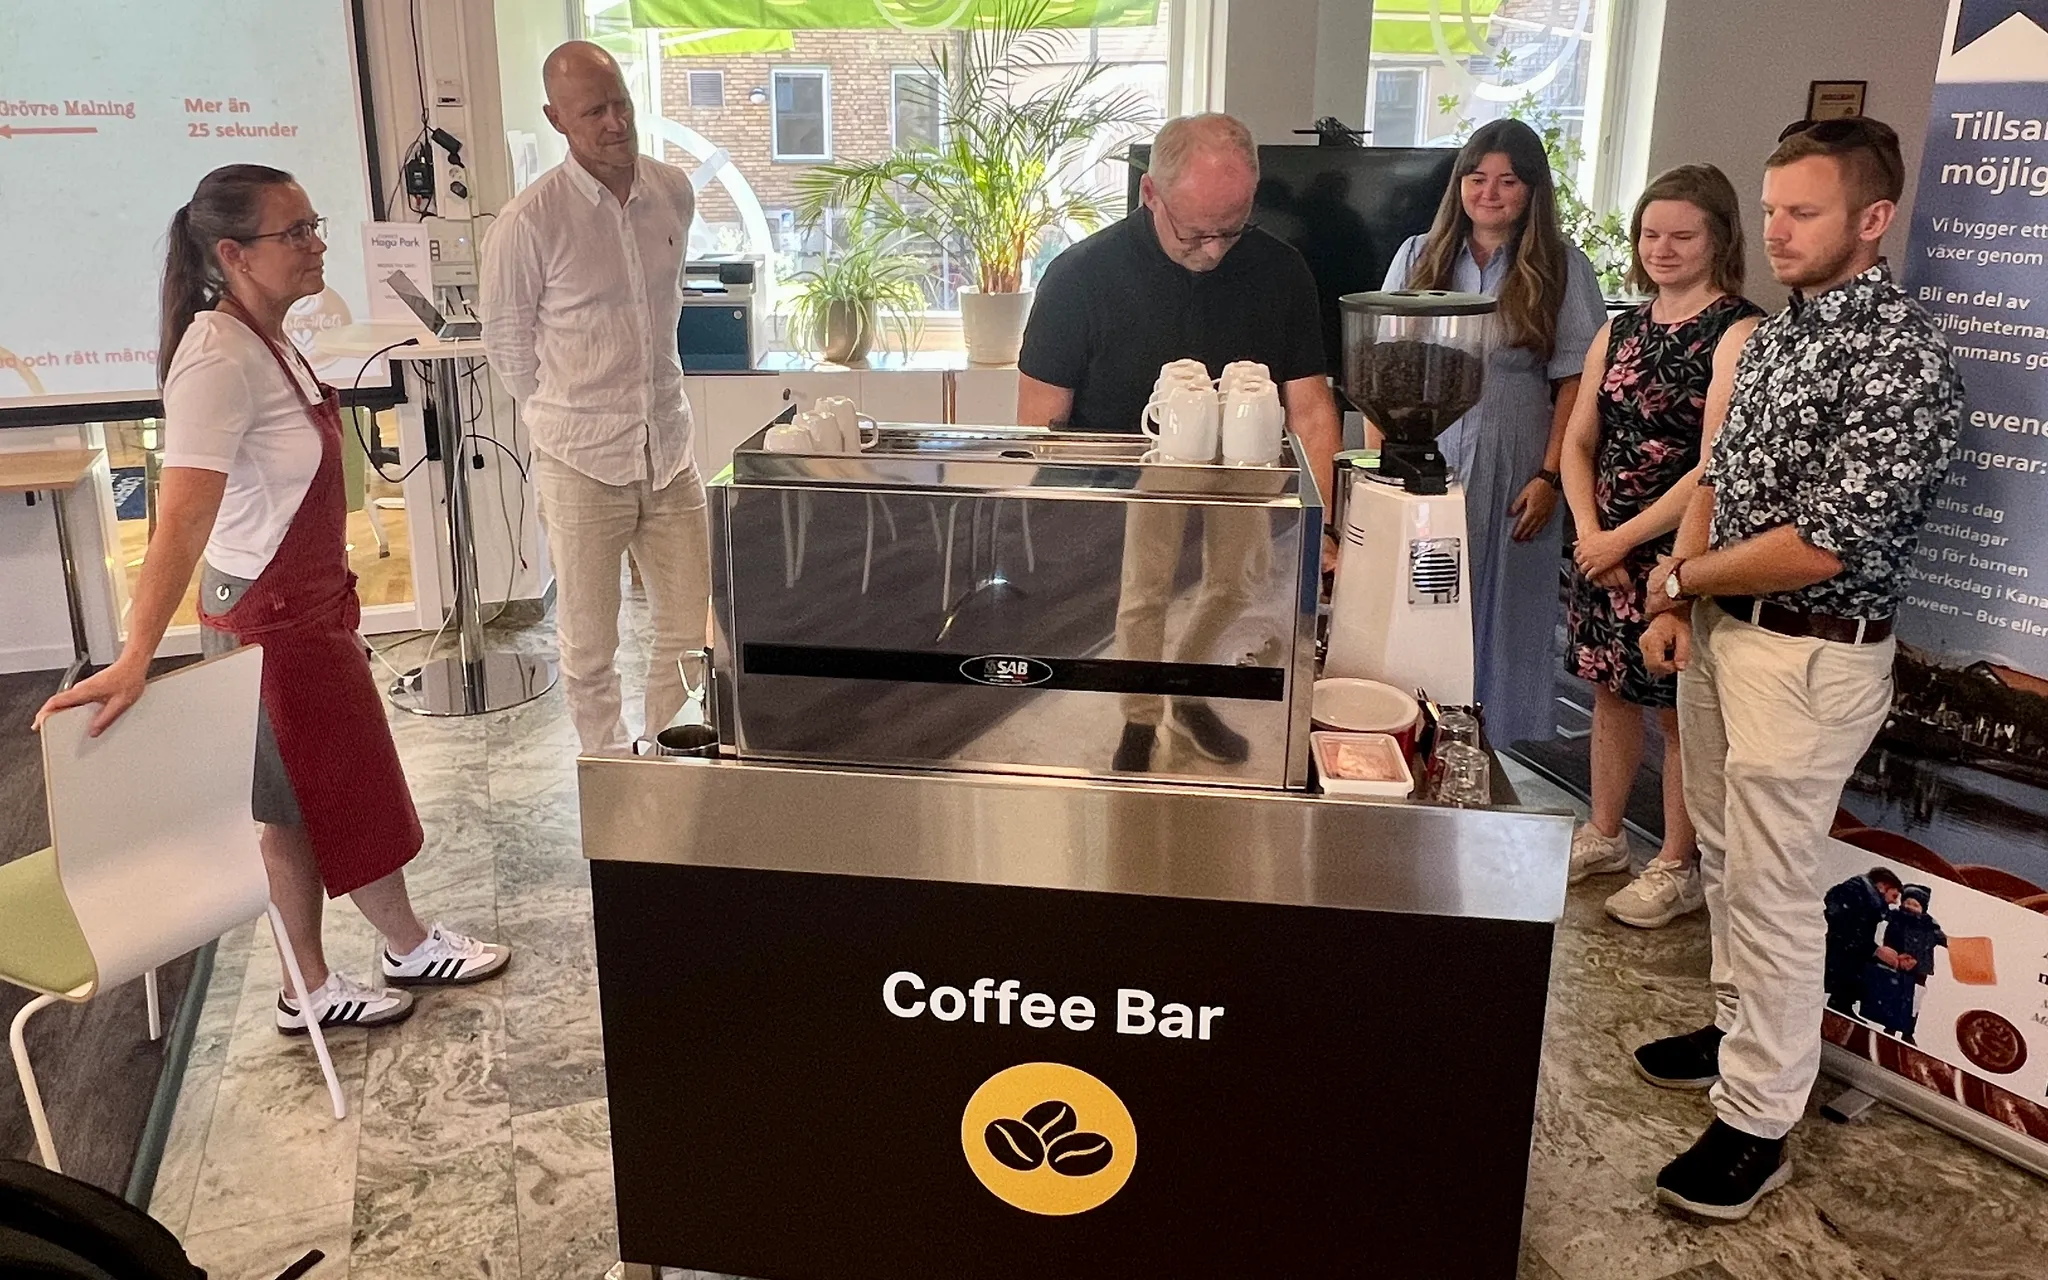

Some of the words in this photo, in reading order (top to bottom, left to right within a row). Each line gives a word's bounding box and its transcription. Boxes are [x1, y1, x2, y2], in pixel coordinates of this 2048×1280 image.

[63, 100, 136, 119] Malning
[184, 98, 223, 113] Mer
[228, 98, 250, 113] än
[187, 122, 211, 138] 25
[215, 121, 298, 138] sekunder
[1950, 111, 2048, 141] Tillsa
[1940, 157, 2048, 196] möjlig
[1932, 217, 1949, 233] Vi
[1952, 218, 2018, 240] bygger
[2020, 223, 2048, 239] ett
[400, 237, 420, 248] Park
[1926, 244, 1975, 260] växer
[1976, 249, 2043, 266] genom
[1919, 286, 1943, 302] Bli
[1946, 291, 1968, 305] en
[1972, 290, 2003, 308] del
[2006, 297, 2031, 310] av
[23, 352, 60, 368] och
[65, 349, 101, 366] rätt
[1972, 503, 2005, 524] dag
[1942, 546, 1967, 565] för
[1969, 553, 2029, 578] barnen
[1996, 584, 2002, 598] i
[1976, 609, 2007, 628] Bus
[997, 661, 1028, 675] SAB
[882, 971, 1096, 1032] Coffee
[1116, 988, 1225, 1040] Bar
